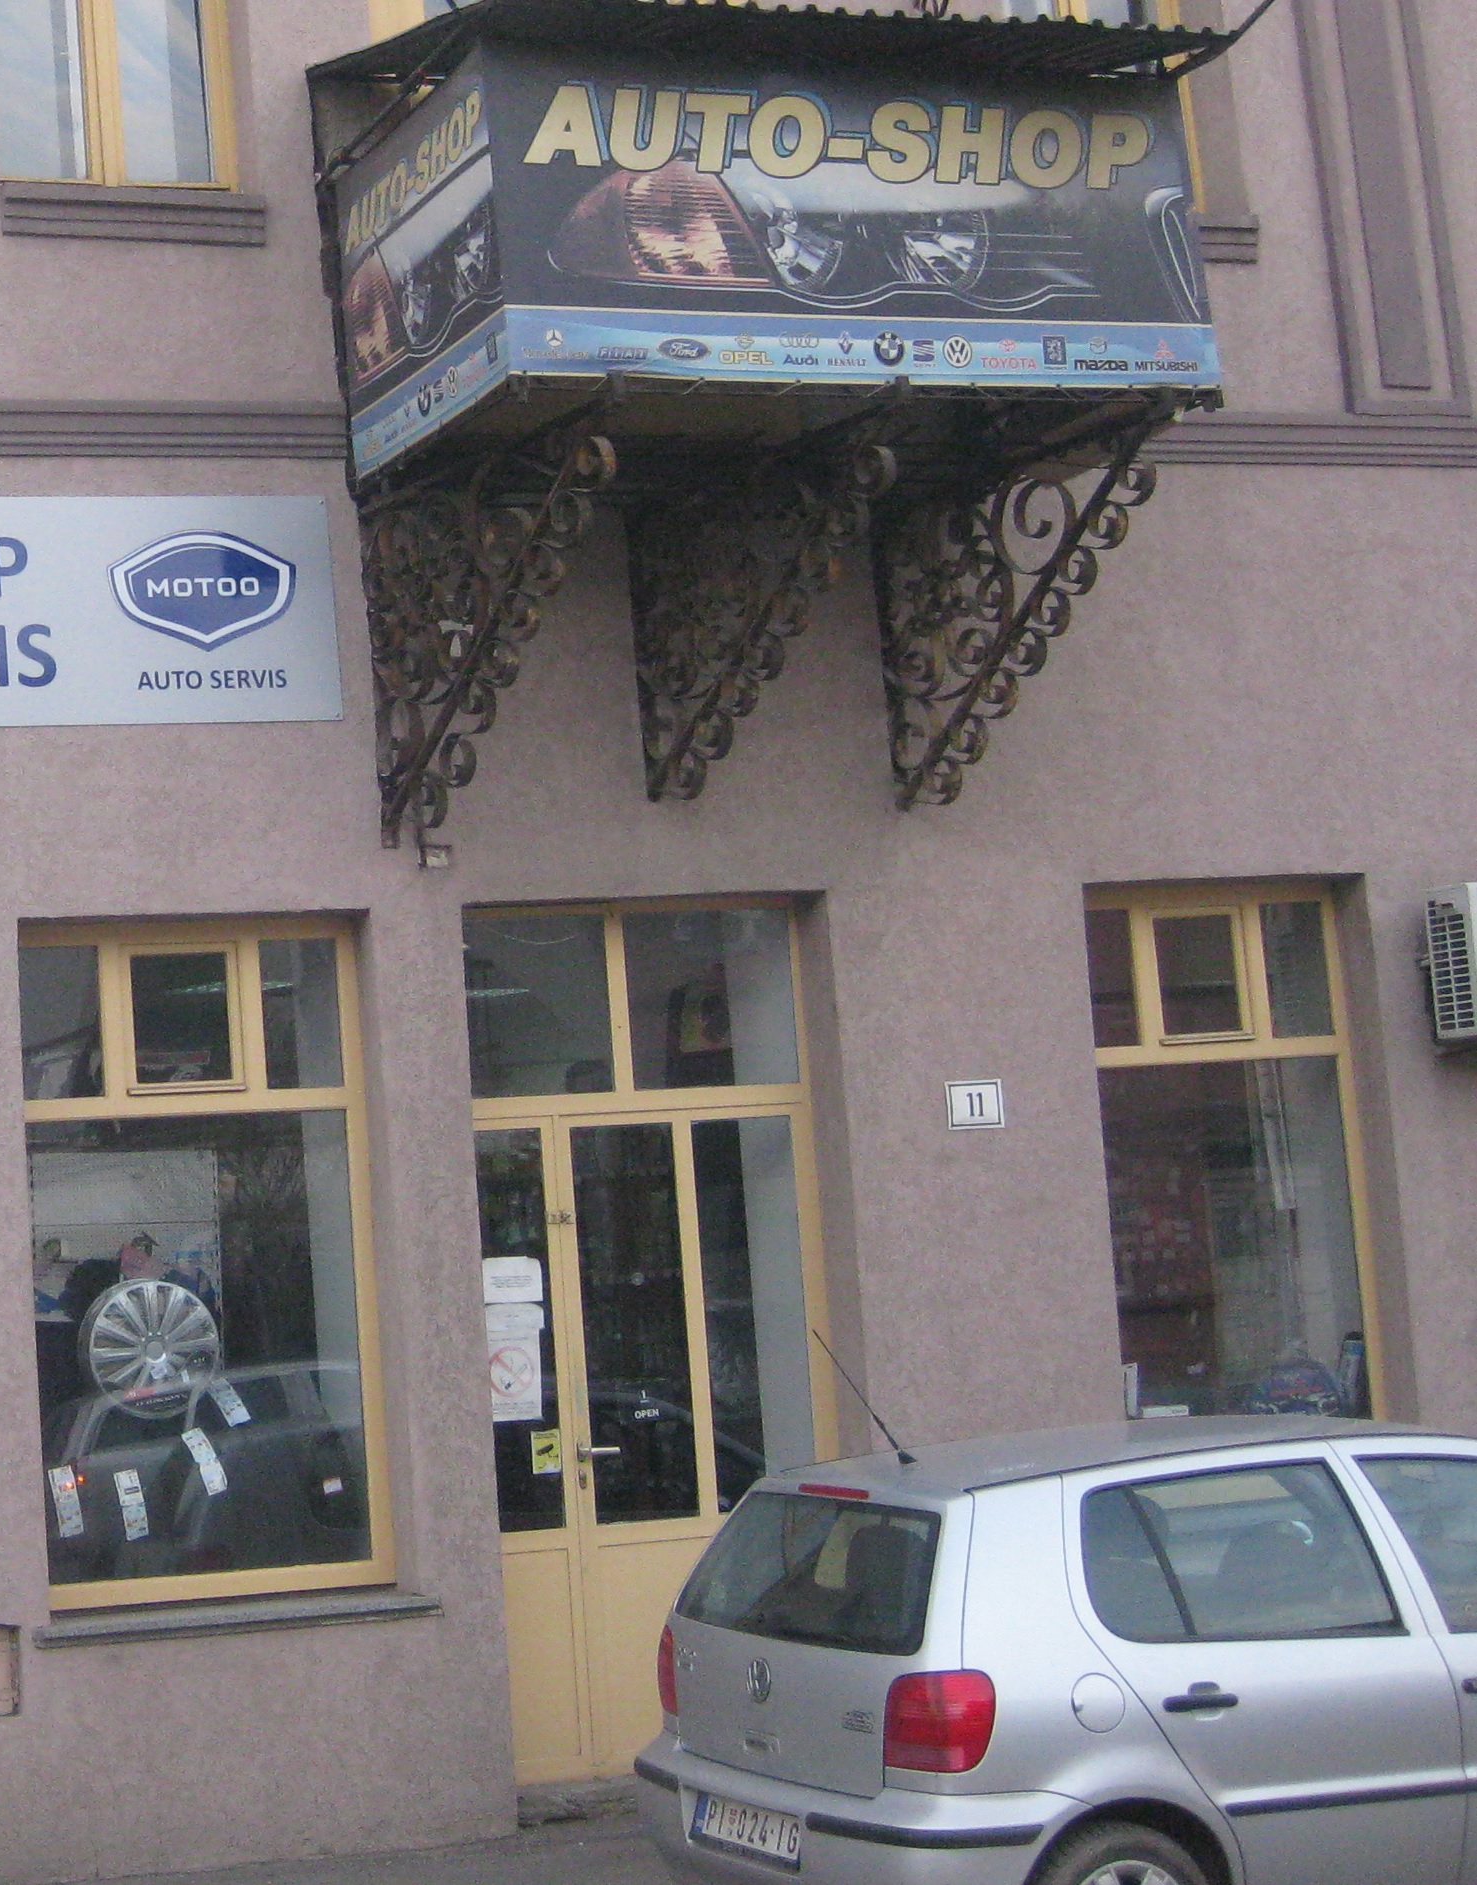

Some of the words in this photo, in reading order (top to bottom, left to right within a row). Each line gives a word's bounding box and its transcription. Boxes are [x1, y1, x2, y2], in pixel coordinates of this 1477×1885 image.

[523, 84, 1152, 190] AUTO-SHOP
[343, 89, 483, 257] AUTO-SHOP
[597, 347, 650, 360] FIAT
[669, 342, 700, 358] Ford
[719, 350, 774, 365] OPEL
[783, 352, 819, 366] Audi
[827, 357, 867, 367] RENAULT
[981, 356, 1037, 370] TOYOTA
[1074, 359, 1129, 372] mazda
[1134, 360, 1199, 372] MITSUBISHI
[146, 577, 261, 599] MOTOO
[137, 669, 204, 691] AUTO
[210, 667, 289, 690] SERVIS
[966, 1092, 985, 1117] 11
[634, 1408, 660, 1419] OPEN
